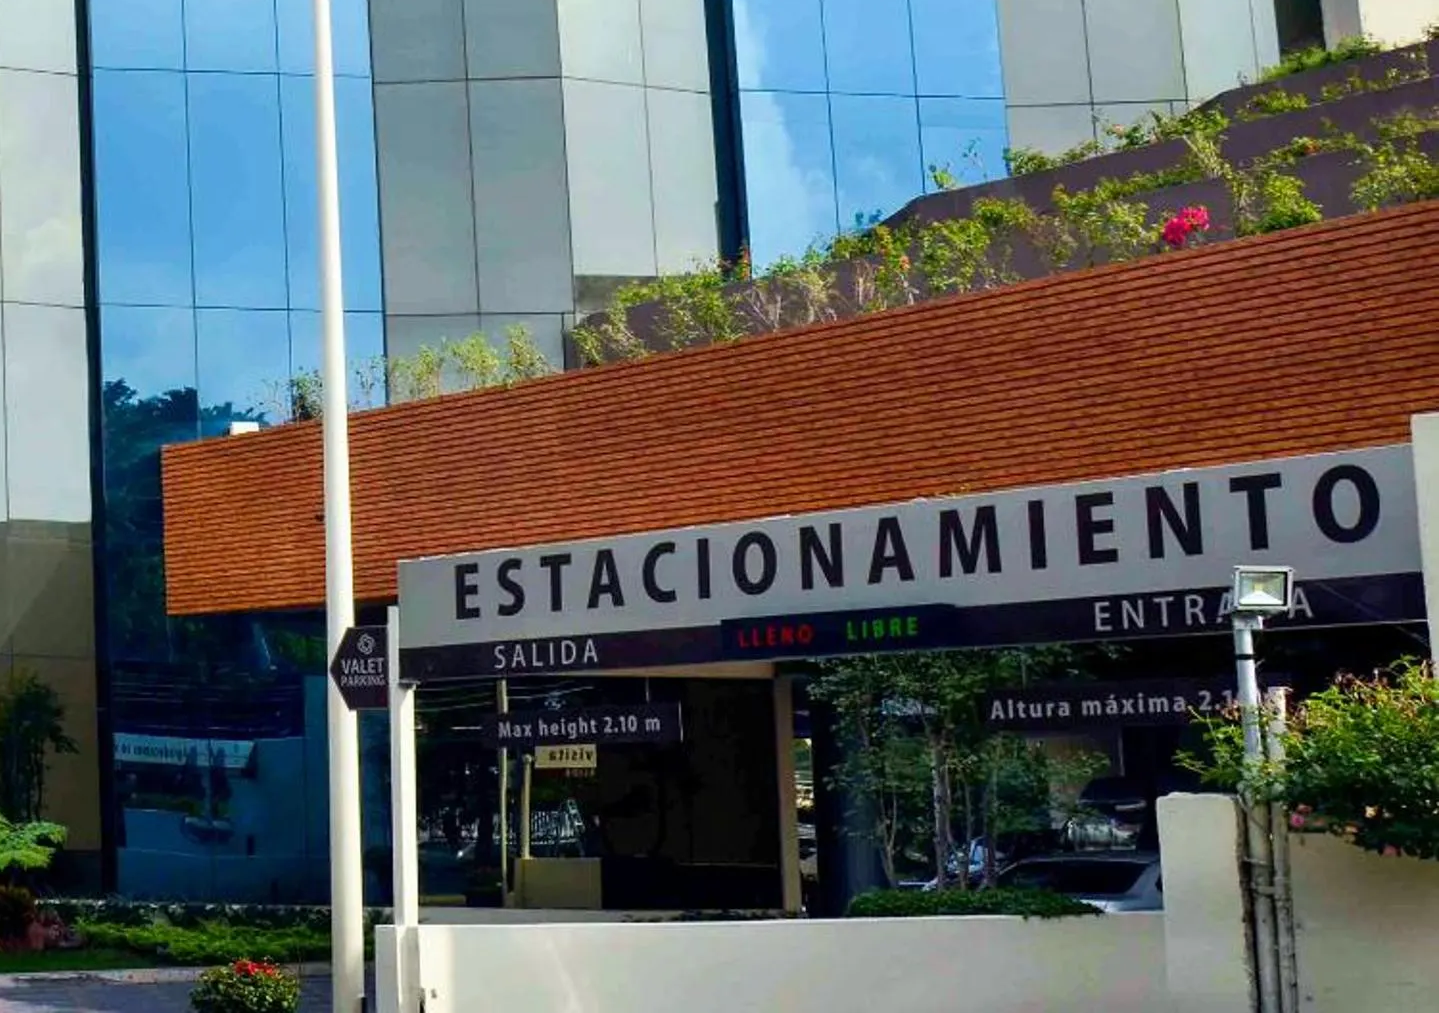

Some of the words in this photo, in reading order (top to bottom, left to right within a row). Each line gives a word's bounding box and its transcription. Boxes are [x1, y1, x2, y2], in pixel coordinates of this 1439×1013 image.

[454, 464, 1380, 620] ESTACIONAMIENTO
[1093, 587, 1314, 632] ENTRAA
[737, 623, 815, 648] LLENO
[846, 616, 919, 640] LIBRE
[341, 657, 384, 675] VALET
[494, 639, 598, 669] SALIDA
[340, 674, 386, 687] PARKING
[990, 699, 1070, 720] Altura
[1081, 692, 1187, 716] máxima
[1198, 689, 1235, 711] 2.1
[498, 721, 532, 738] Max
[538, 717, 597, 739] height
[603, 715, 638, 734] 2.10
[645, 717, 660, 732] m
